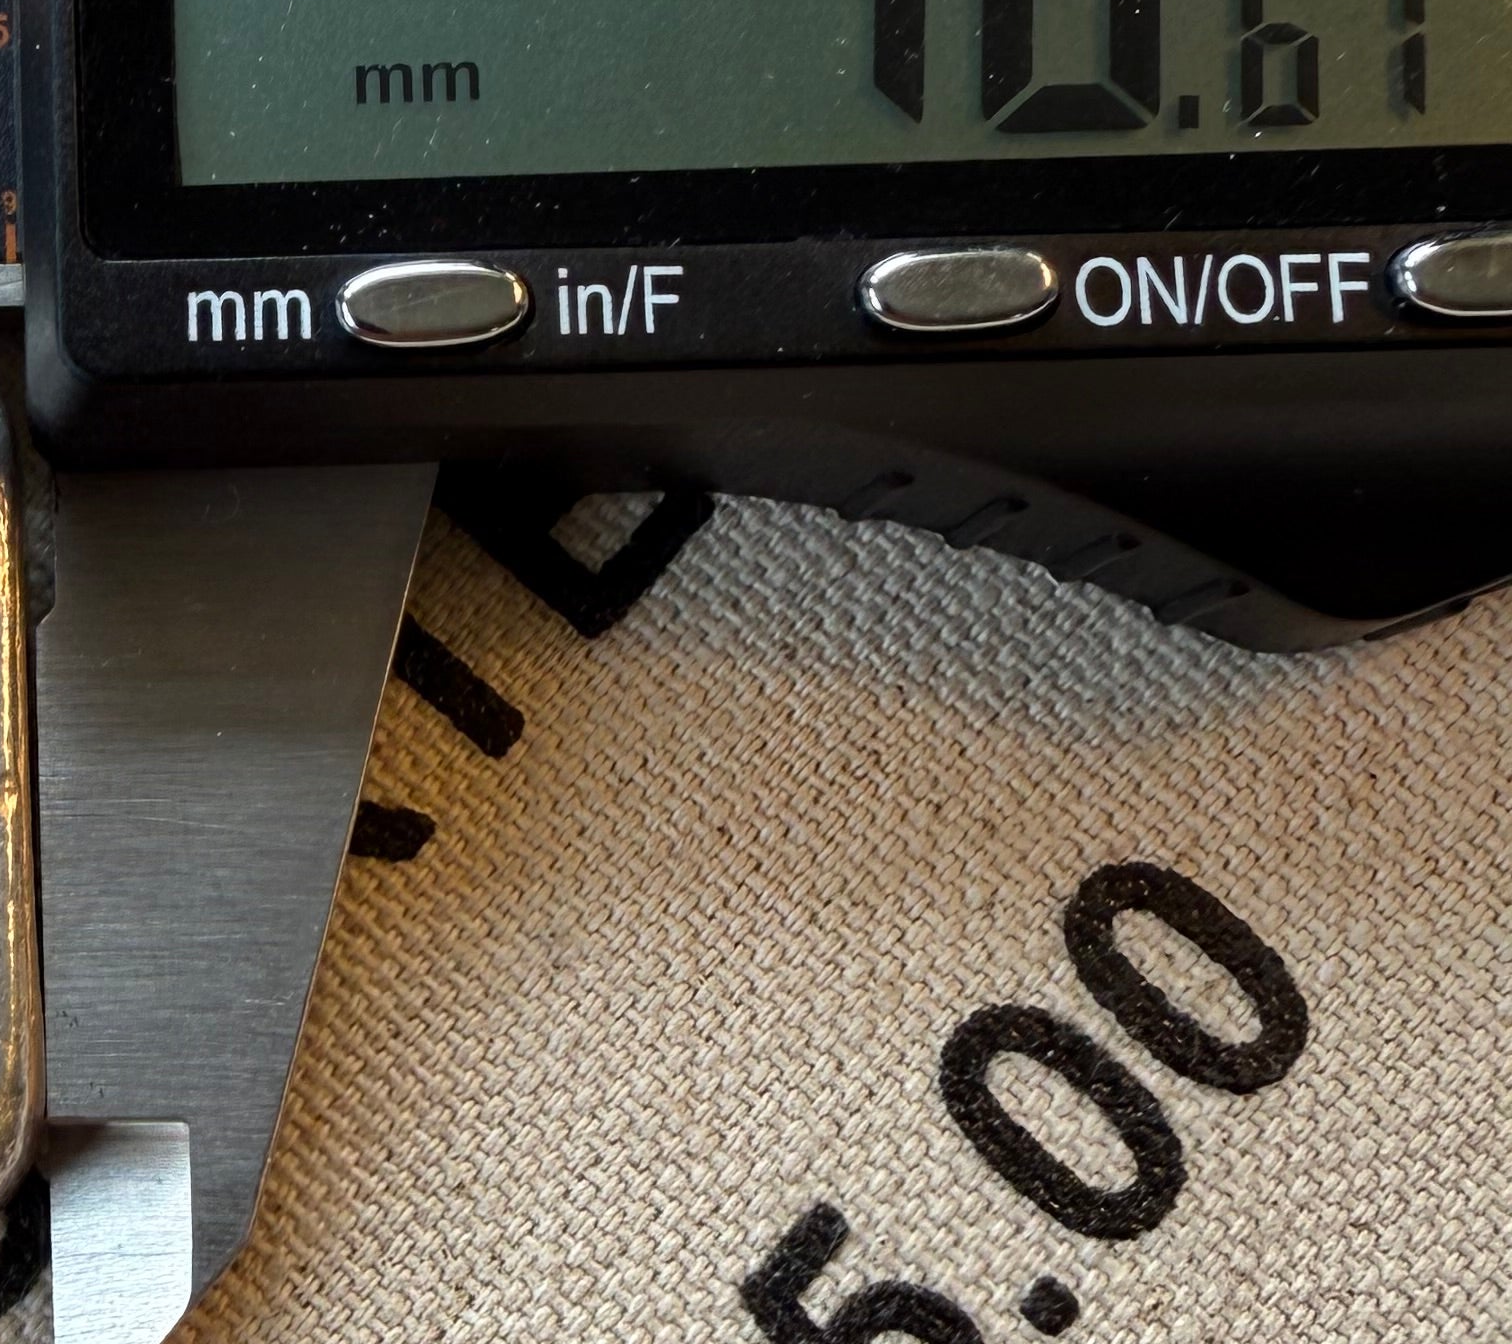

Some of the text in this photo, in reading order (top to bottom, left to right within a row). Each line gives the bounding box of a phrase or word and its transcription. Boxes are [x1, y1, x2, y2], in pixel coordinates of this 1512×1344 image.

[354, 55, 481, 106] mm
[185, 285, 314, 344] mm
[556, 263, 685, 339] in/F
[1075, 251, 1373, 328] ON/OFF
